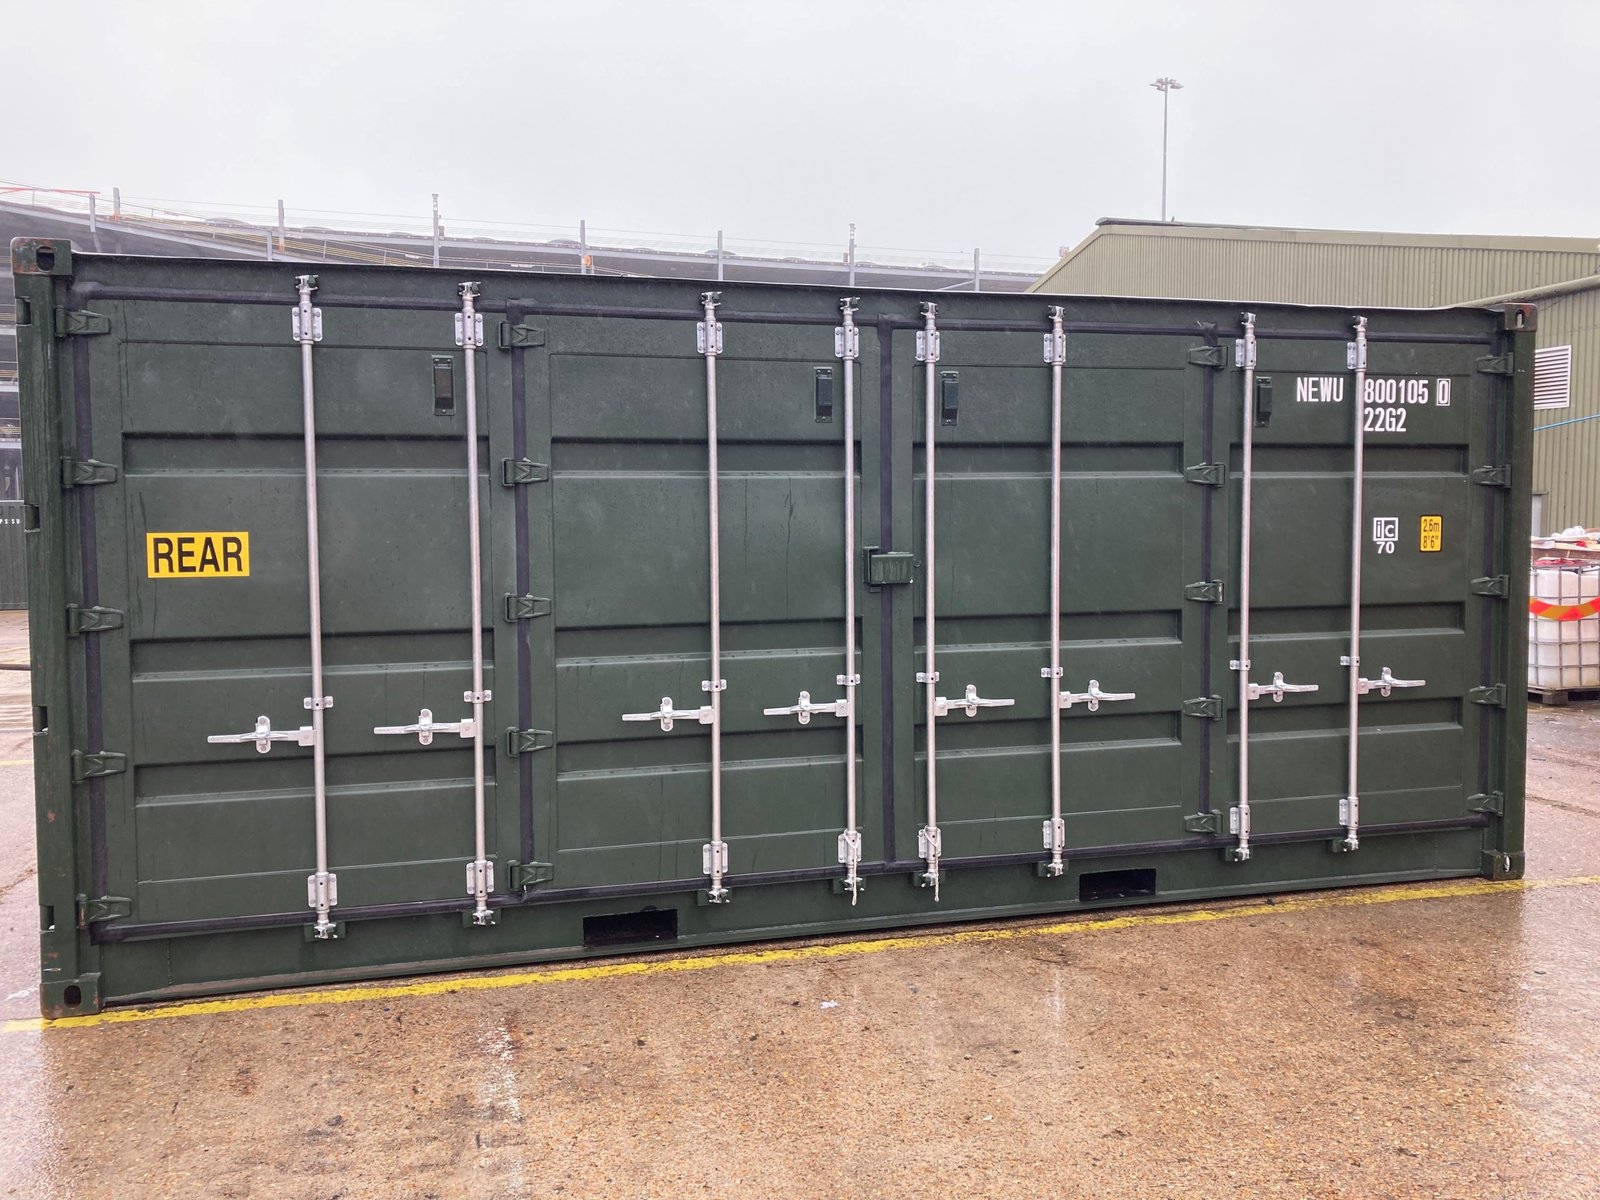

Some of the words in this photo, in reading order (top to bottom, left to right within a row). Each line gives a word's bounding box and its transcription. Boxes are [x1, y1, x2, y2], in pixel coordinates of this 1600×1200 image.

[1296, 377, 1344, 402] NEWU
[1364, 378, 1429, 404] 800105
[1364, 407, 1407, 432] 22G2
[153, 536, 243, 573] REAR
[1376, 541, 1395, 554] 70
